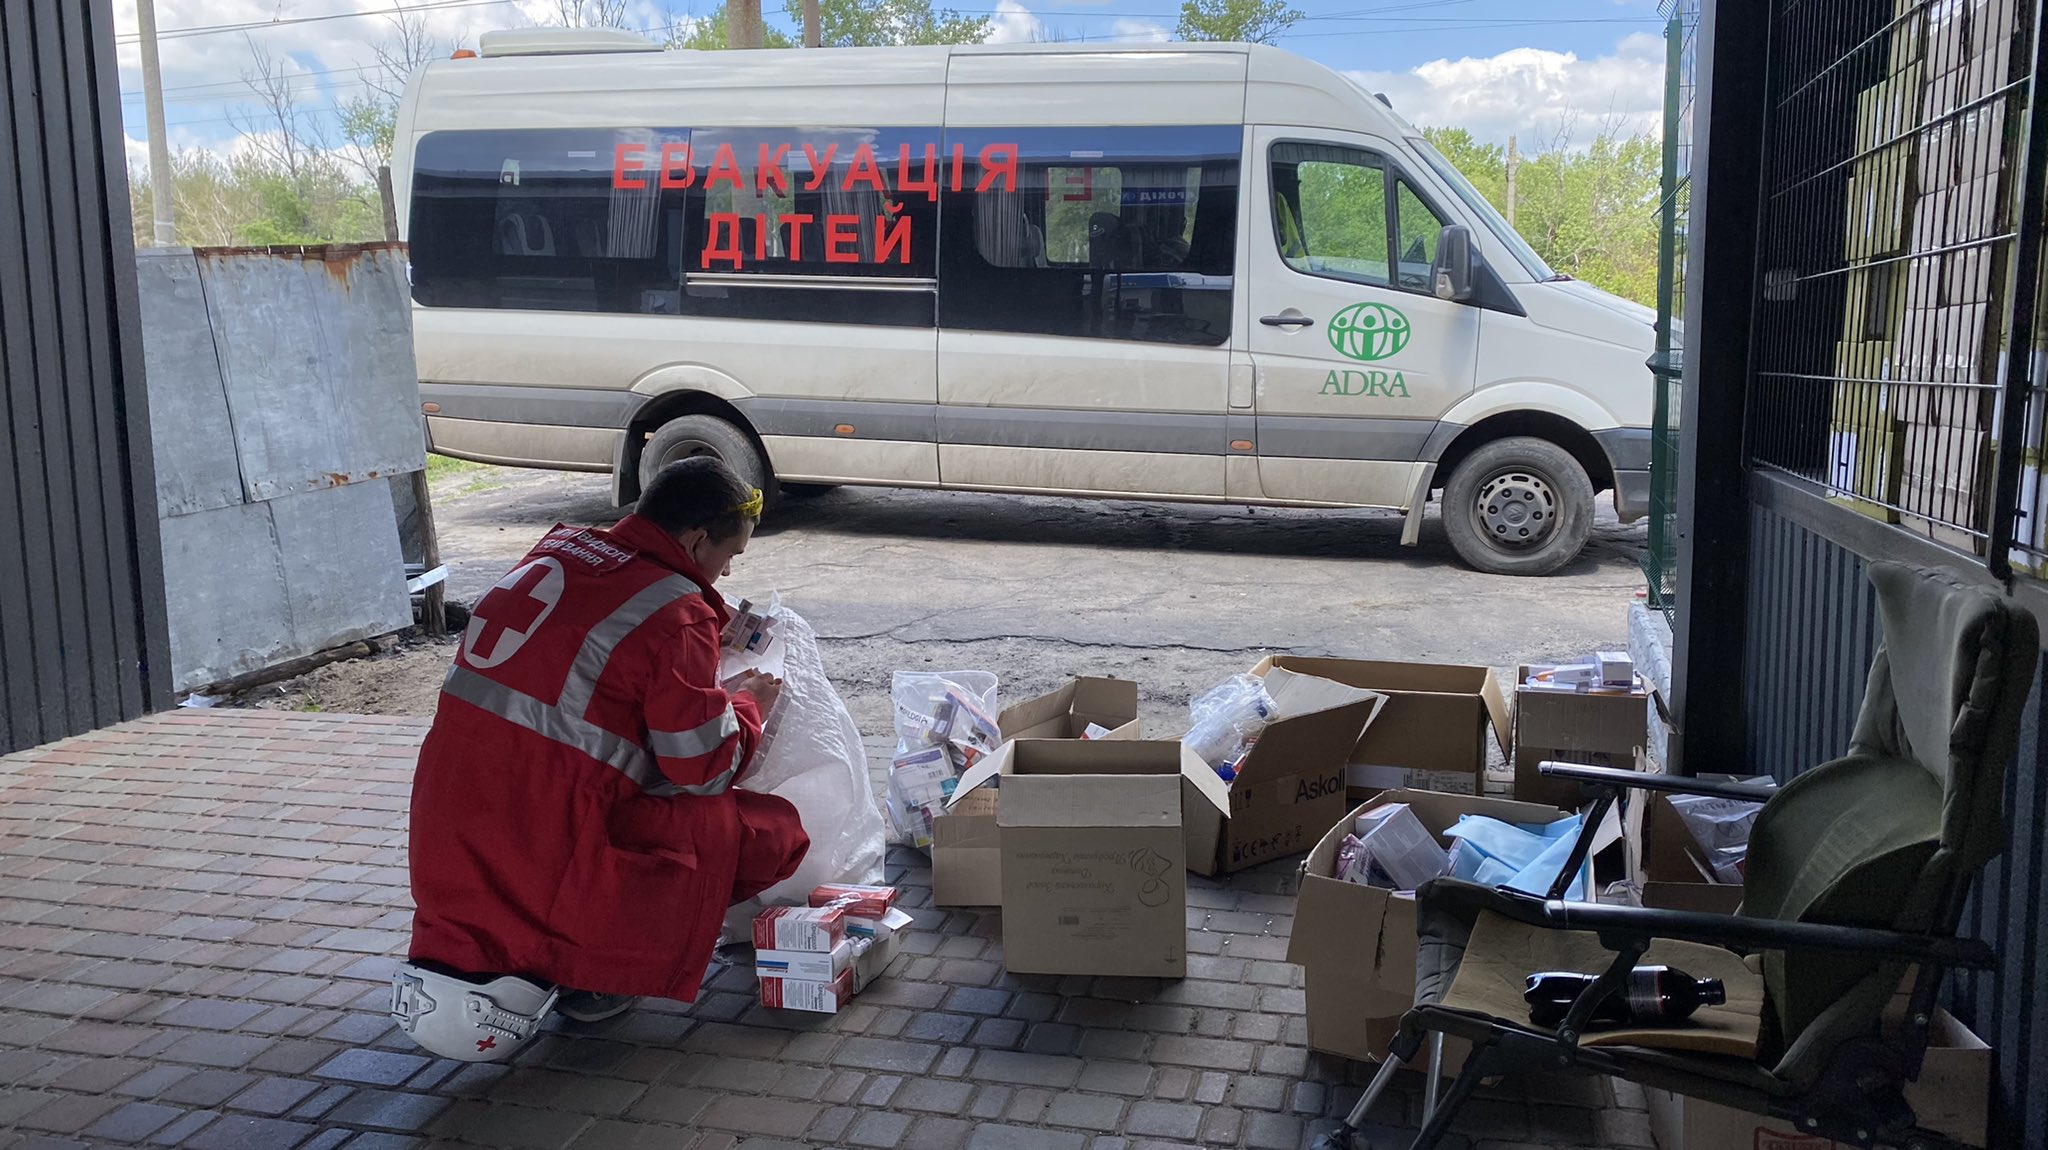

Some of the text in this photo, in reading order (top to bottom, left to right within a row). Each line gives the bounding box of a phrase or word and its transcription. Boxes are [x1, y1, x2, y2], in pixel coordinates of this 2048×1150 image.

[612, 143, 1018, 201] ЕВАКУАЦІЯ
[701, 203, 912, 269] ДІТЕЙ
[1317, 369, 1411, 397] ADRA
[1295, 767, 1345, 804] Askoll
